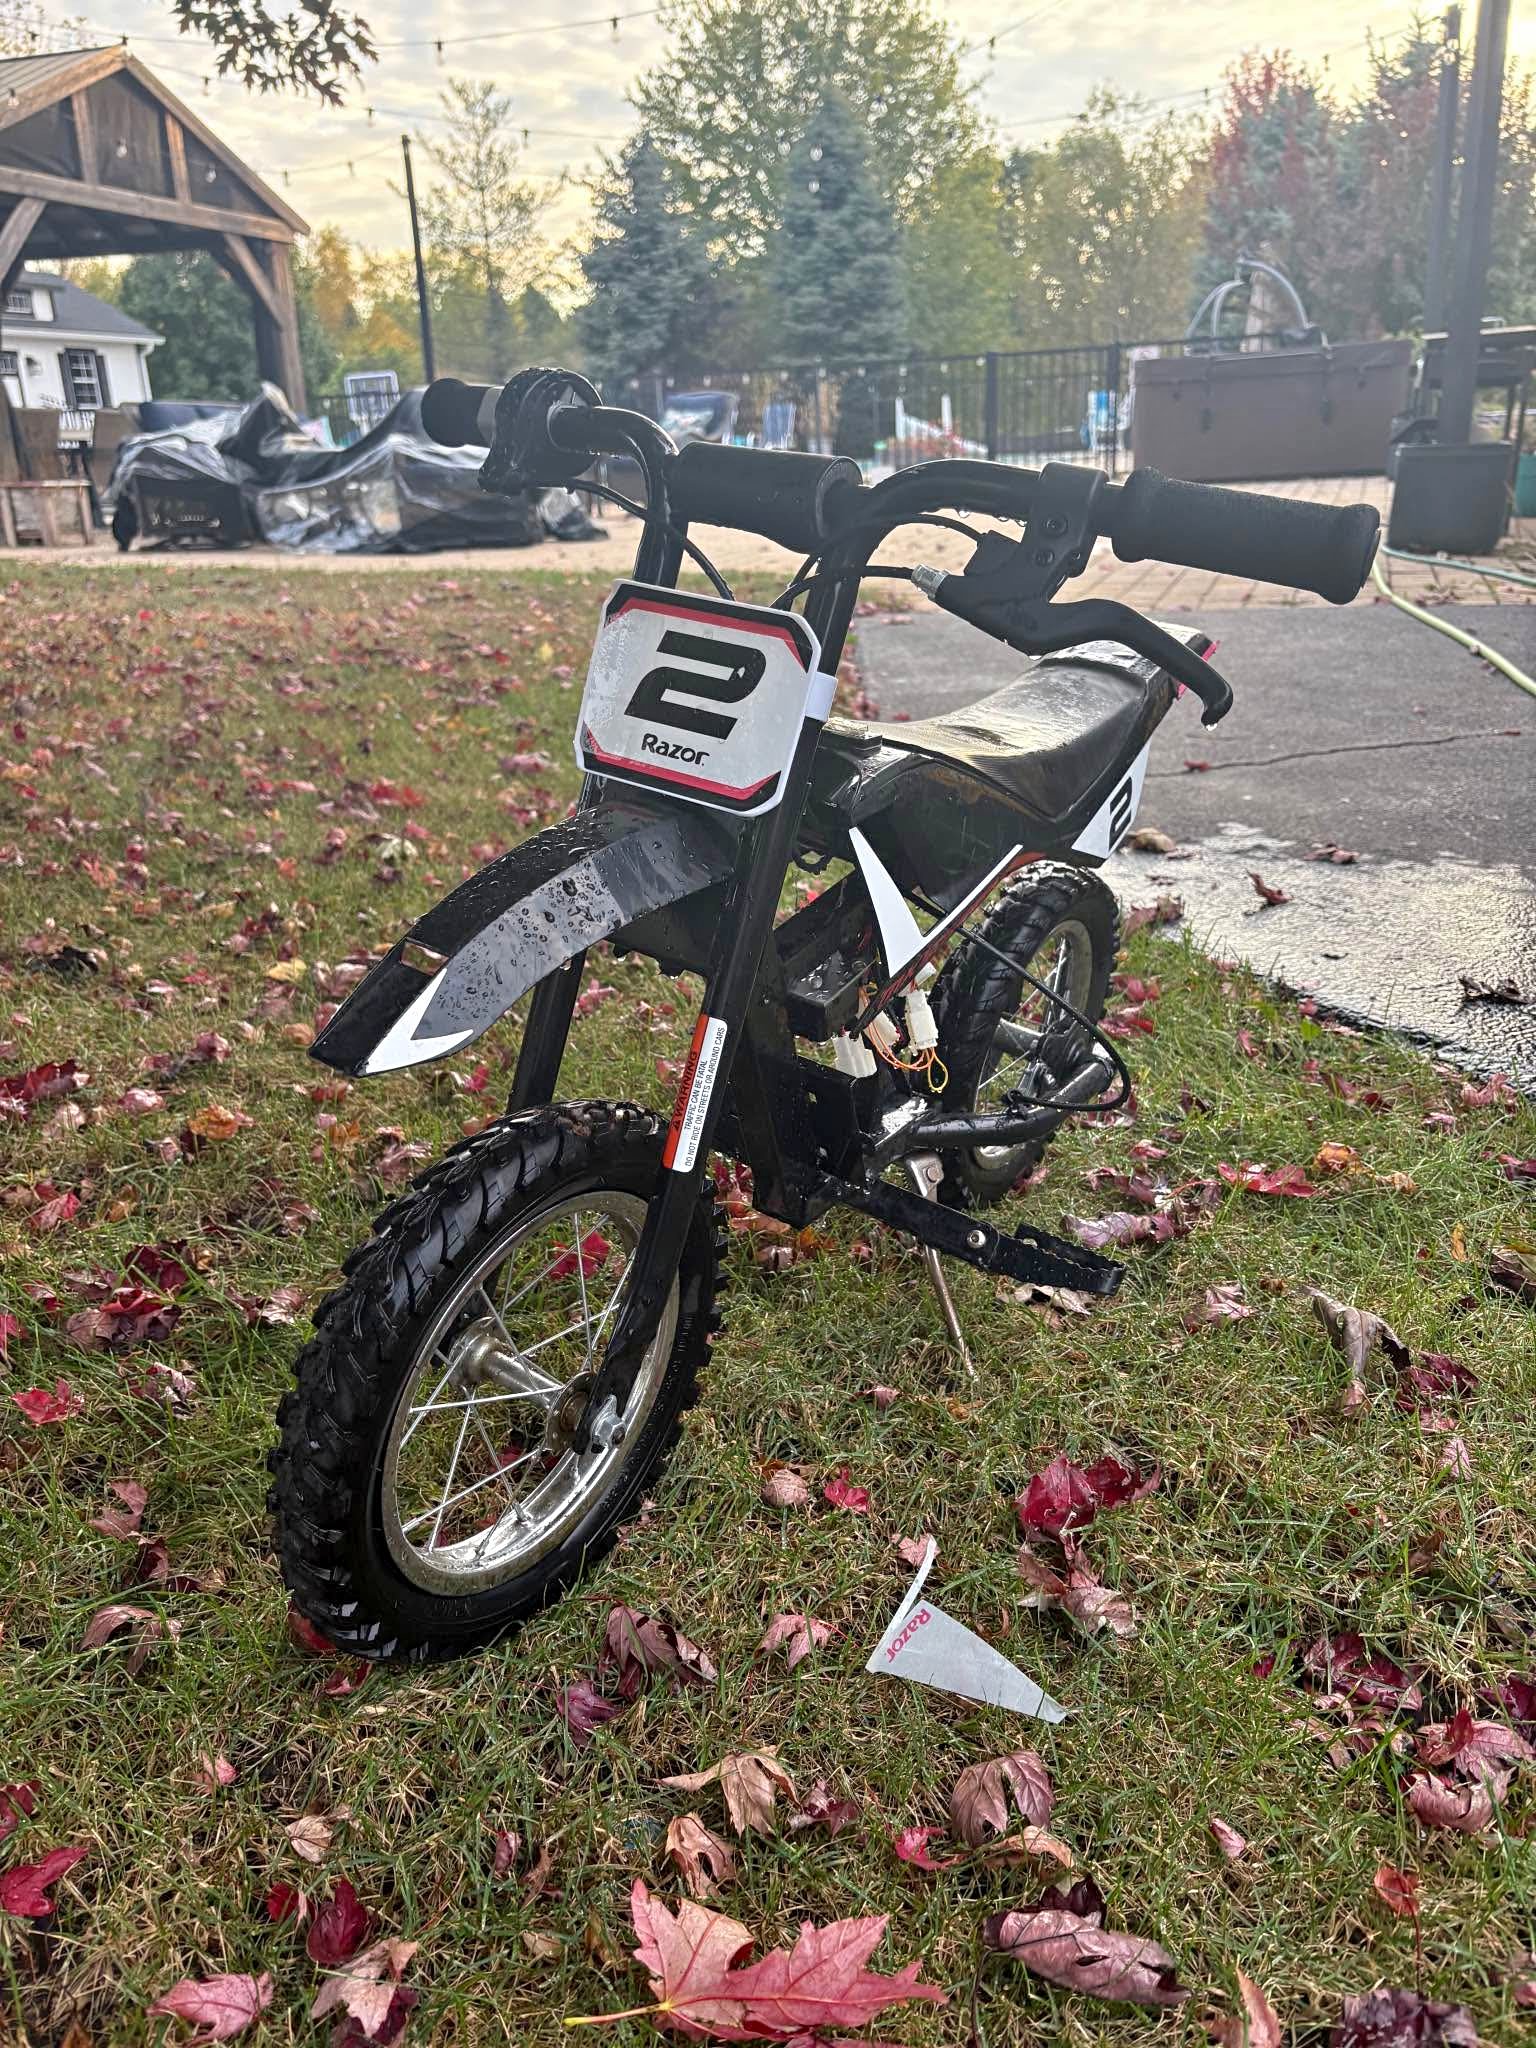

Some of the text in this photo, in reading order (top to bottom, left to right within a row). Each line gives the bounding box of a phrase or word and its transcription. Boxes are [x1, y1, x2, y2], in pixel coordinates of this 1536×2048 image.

[624, 630, 767, 740] 2
[641, 733, 710, 765] Razor
[1109, 776, 1133, 849] 2
[675, 1051, 698, 1118] WARNING
[684, 1060, 708, 1130] TRAFFIC CAN BE FATAL
[685, 1027, 726, 1166] DO NOT RIDE ON STREETS OR AROUND CARS
[886, 1608, 933, 1663] Razor
